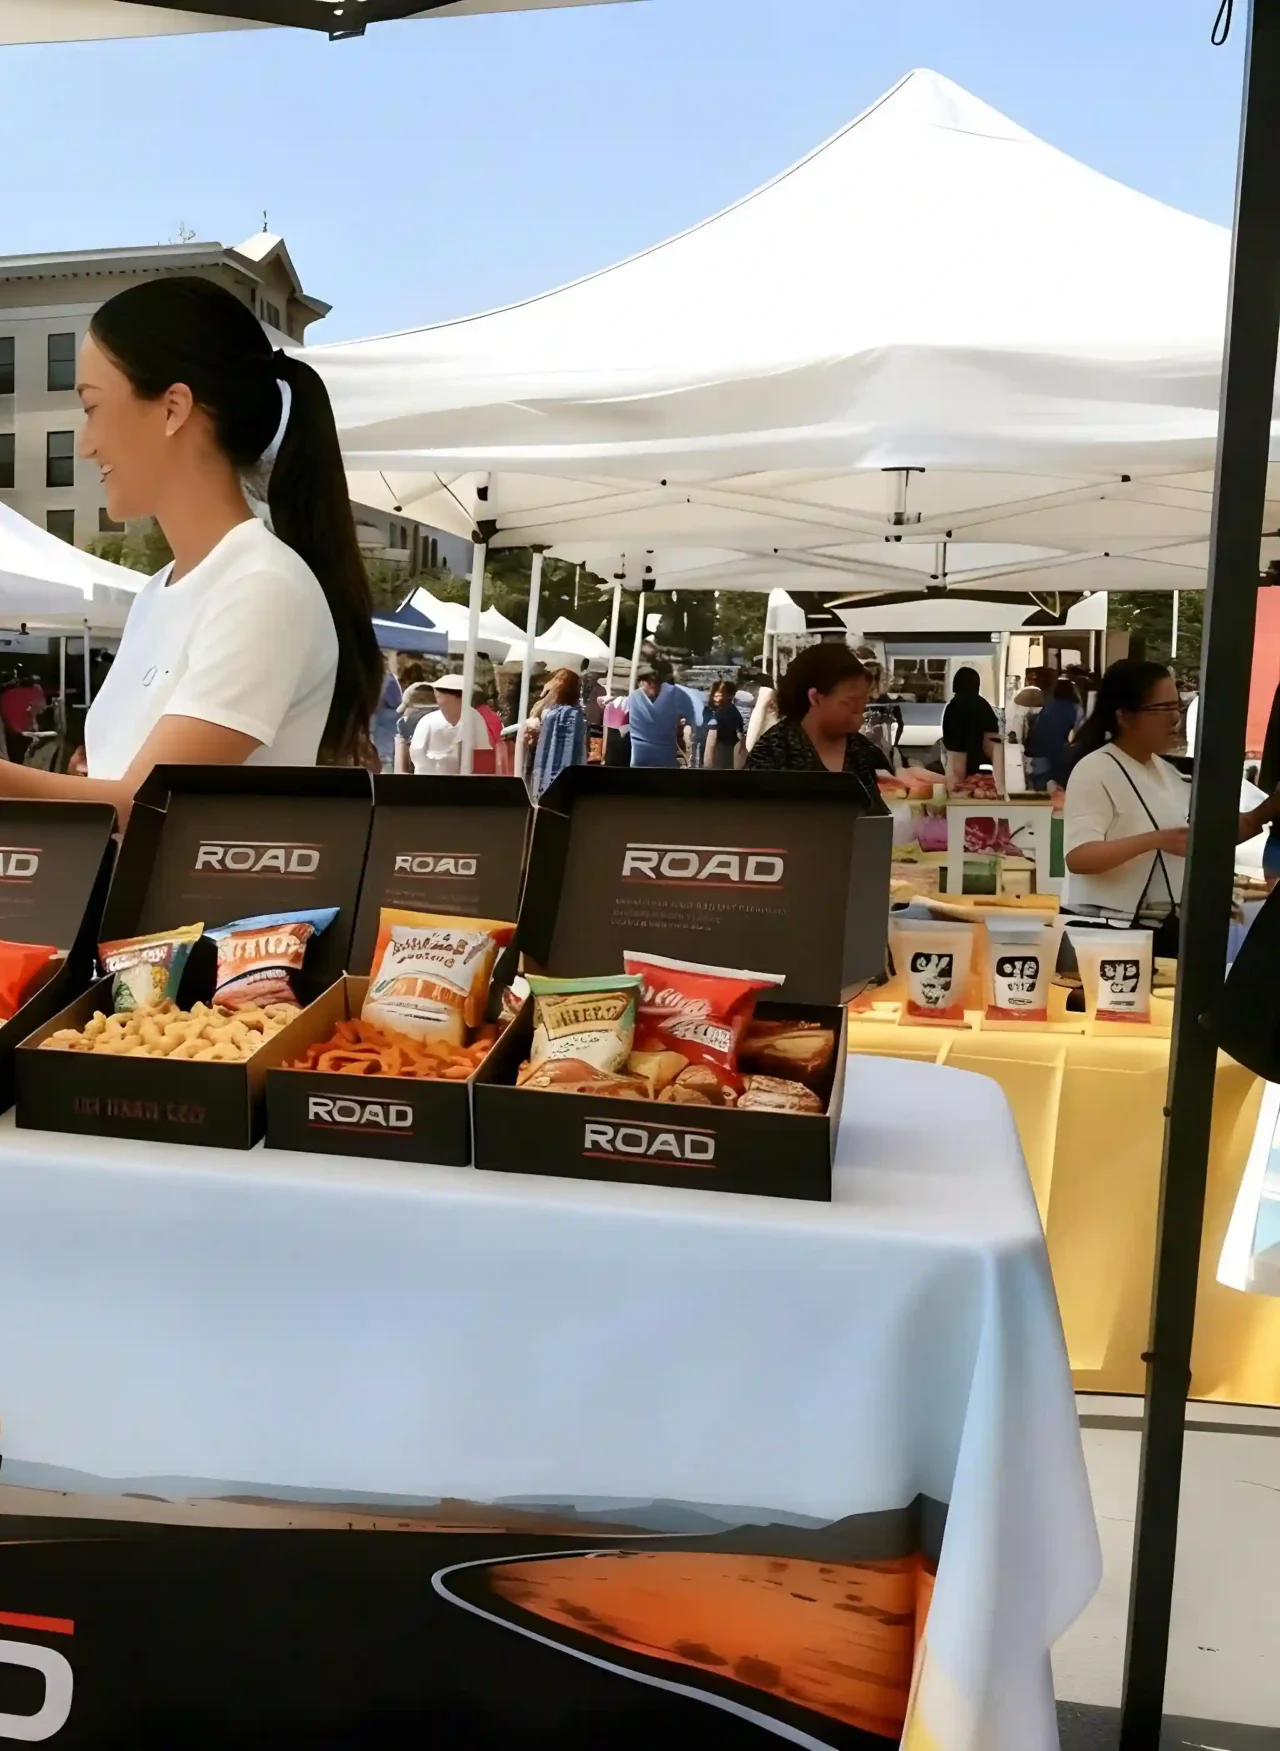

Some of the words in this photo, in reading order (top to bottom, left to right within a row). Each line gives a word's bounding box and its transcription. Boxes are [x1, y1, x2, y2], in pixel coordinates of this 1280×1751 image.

[194, 846, 320, 873] ROAD
[394, 856, 477, 876] ROAD
[622, 850, 785, 882] ROAD
[308, 1098, 413, 1127] ROAD
[583, 1124, 715, 1160] ROAD
